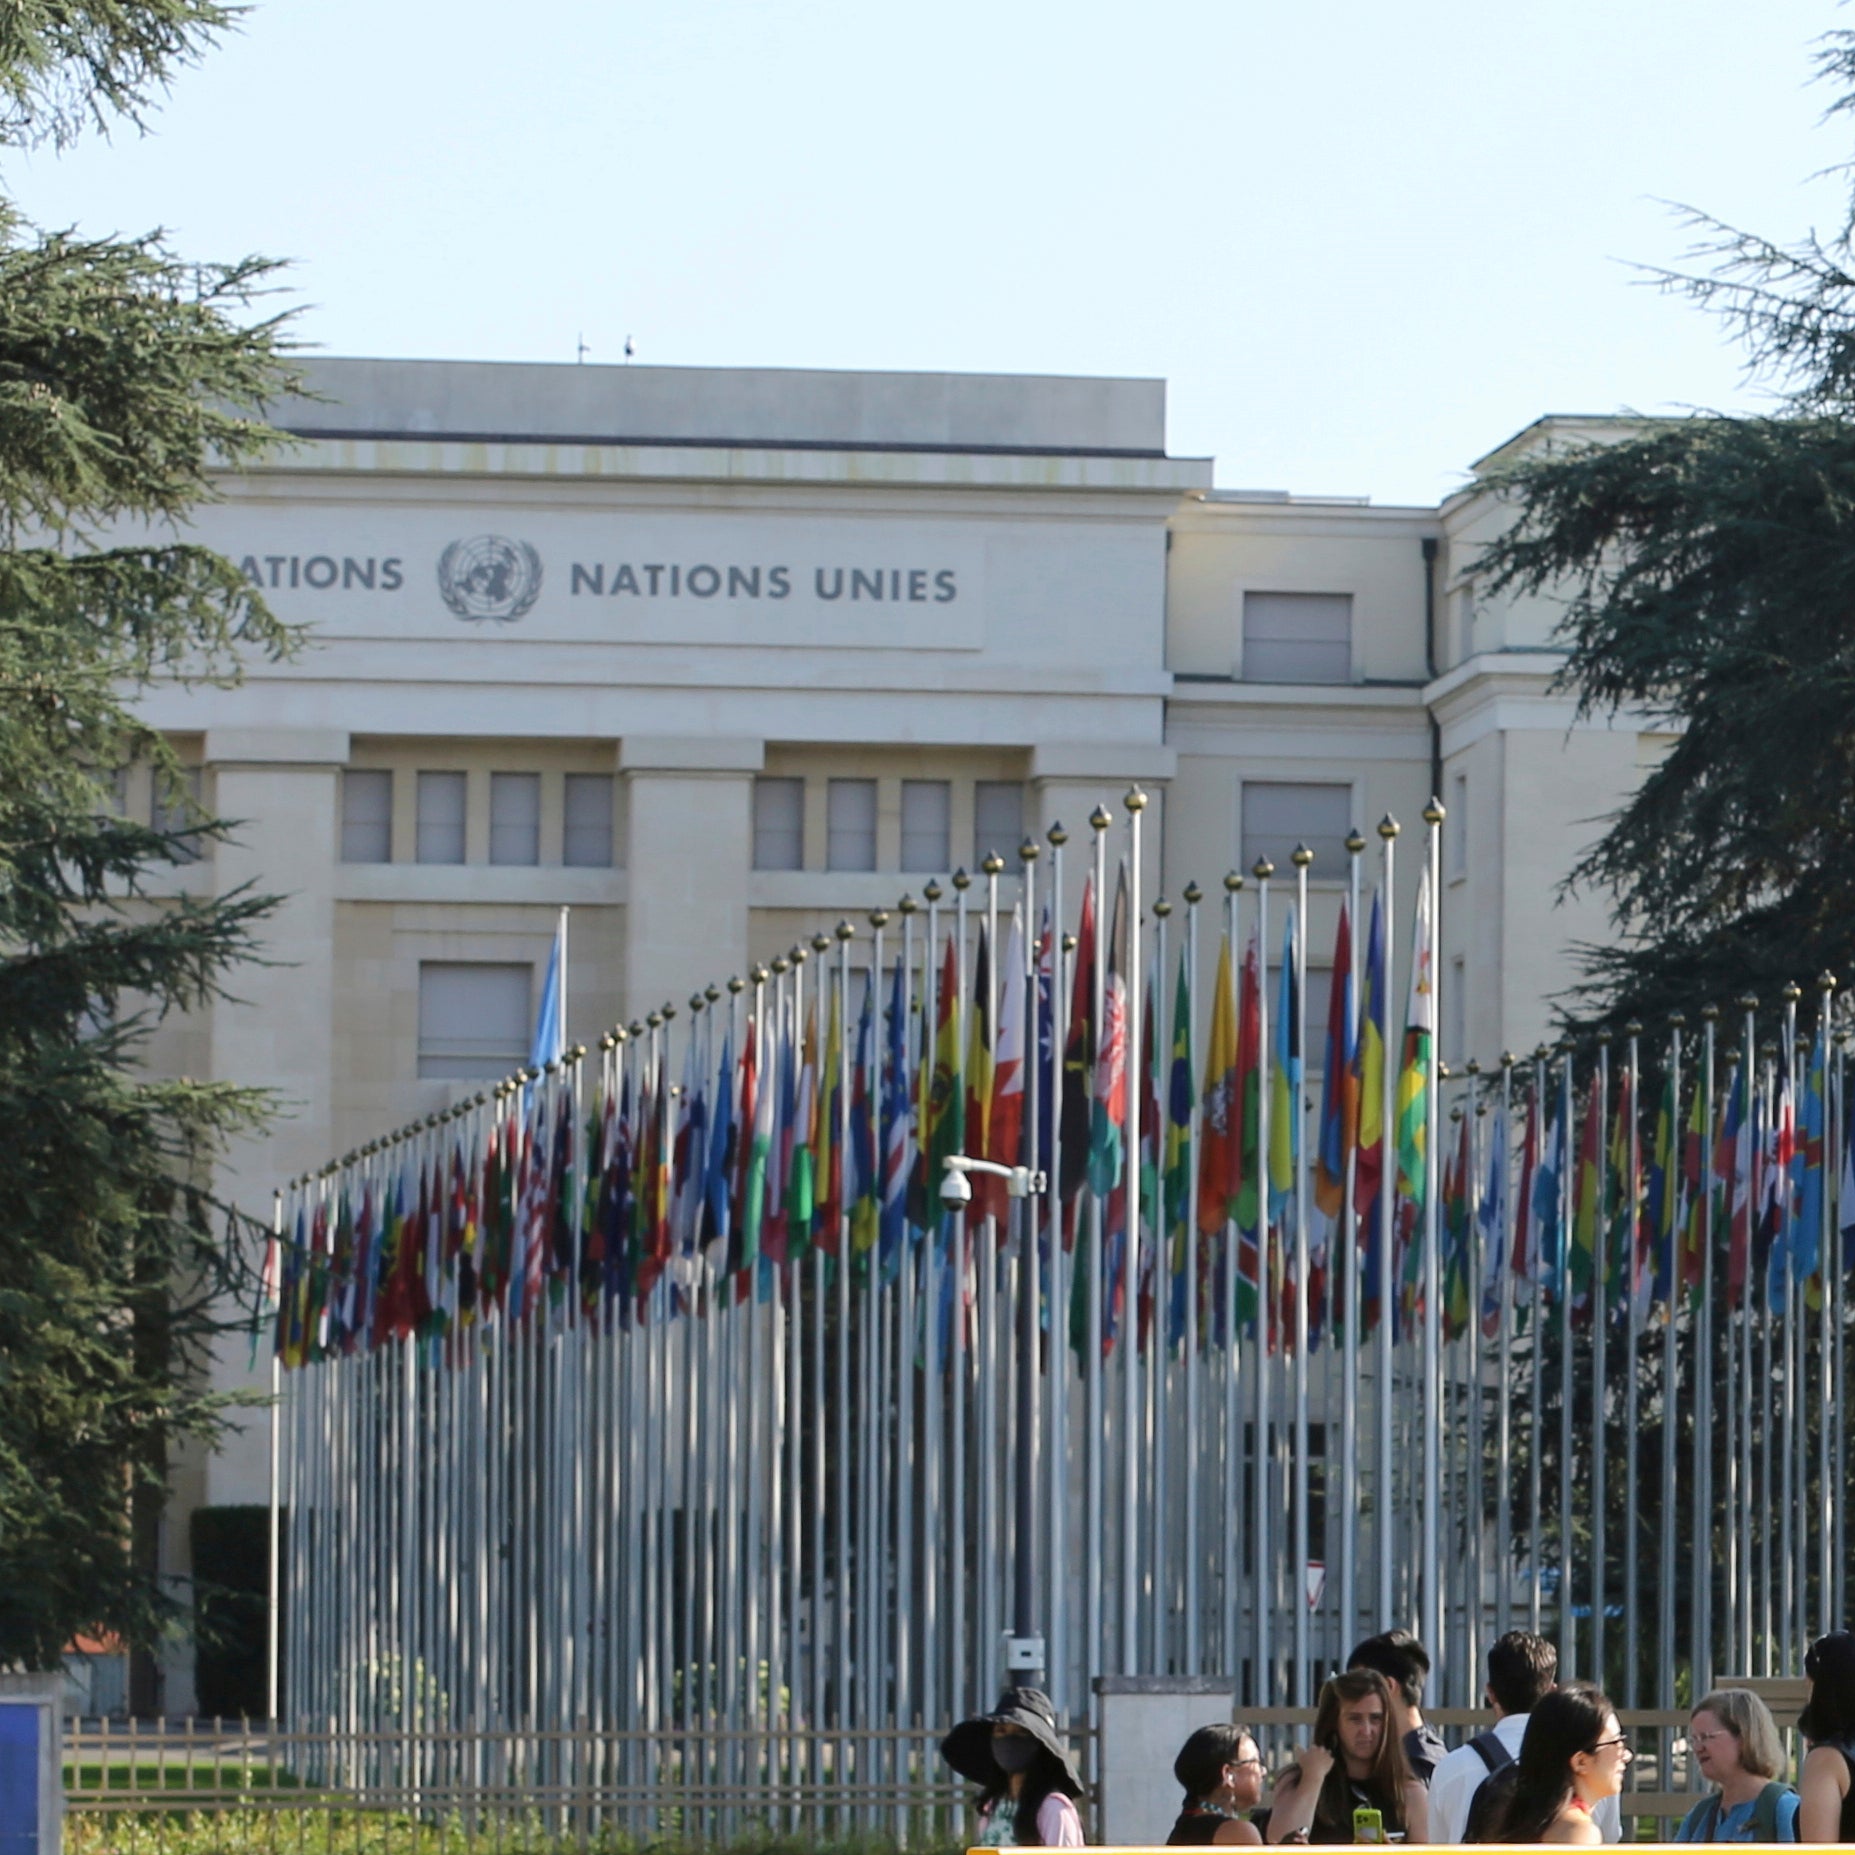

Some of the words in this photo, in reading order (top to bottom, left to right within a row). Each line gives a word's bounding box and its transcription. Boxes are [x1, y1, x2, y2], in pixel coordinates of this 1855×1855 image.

[240, 555, 404, 591] ATIONS
[571, 562, 792, 599] NATIONS
[814, 567, 958, 602] UNIES
